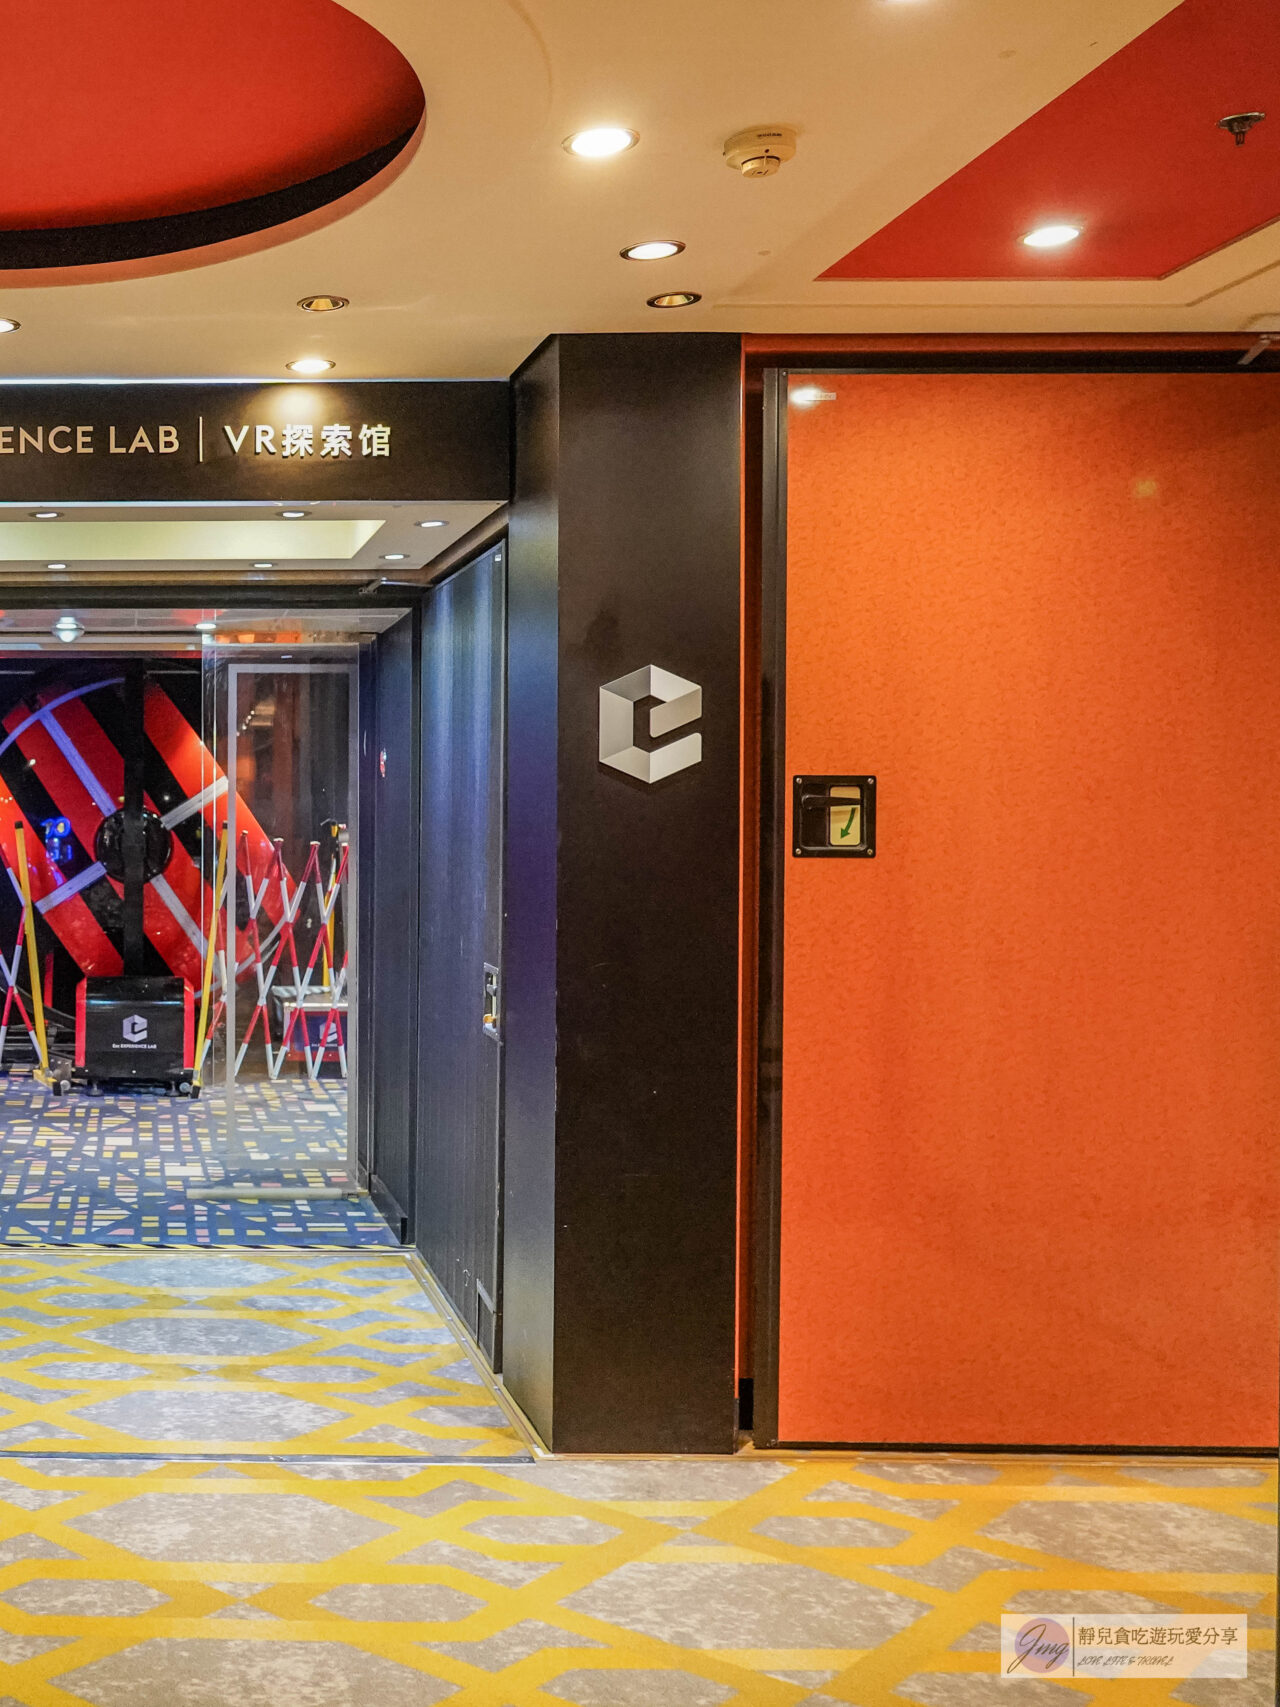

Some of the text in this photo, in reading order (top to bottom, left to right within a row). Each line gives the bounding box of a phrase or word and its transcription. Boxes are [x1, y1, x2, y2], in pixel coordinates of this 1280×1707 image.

[110, 425, 180, 454] LAB
[224, 423, 392, 457] VR探索馆
